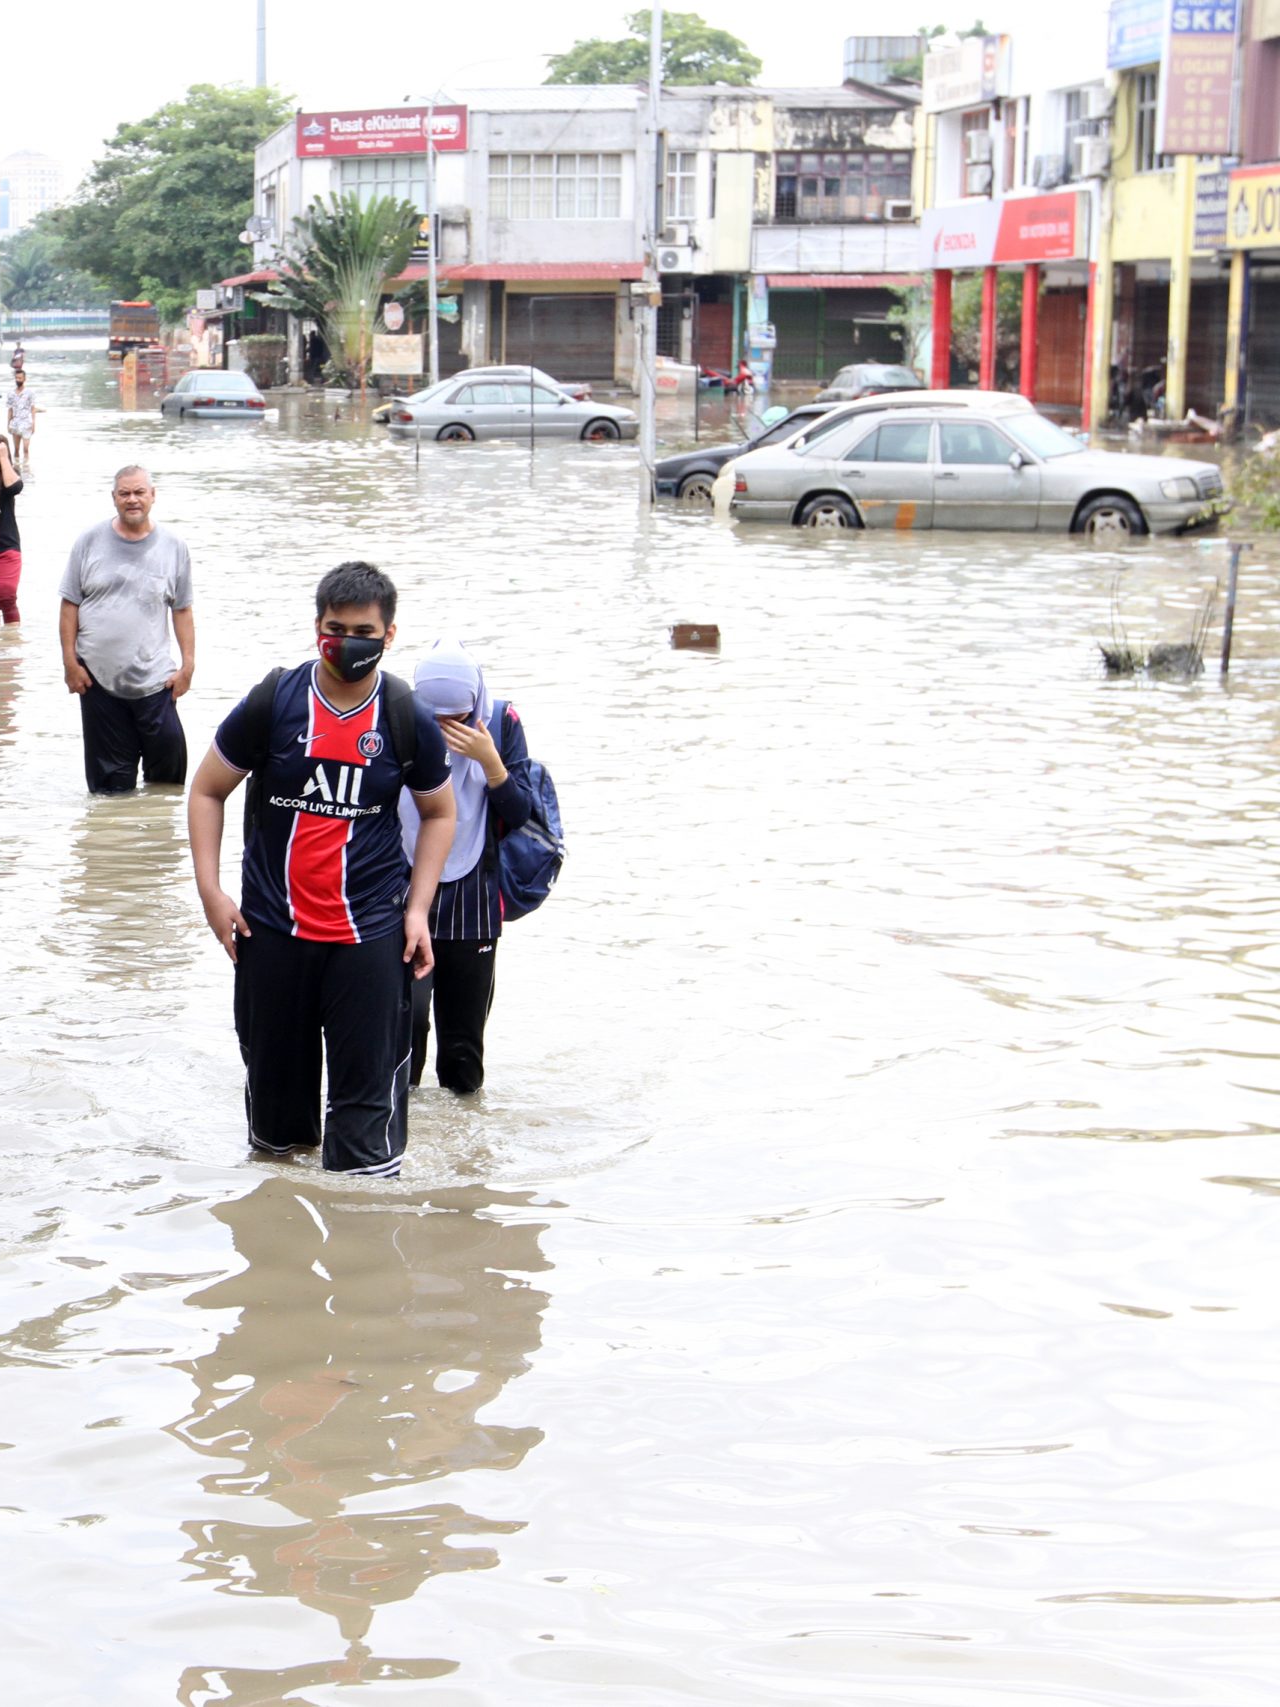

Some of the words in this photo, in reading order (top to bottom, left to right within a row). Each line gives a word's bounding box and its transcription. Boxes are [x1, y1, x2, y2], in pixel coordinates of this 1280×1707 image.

[1173, 8, 1234, 31] SKK
[330, 117, 364, 133] Pusat
[365, 114, 421, 131] eKhidmat
[270, 795, 308, 810] ACCOR
[309, 802, 334, 814] LIVE
